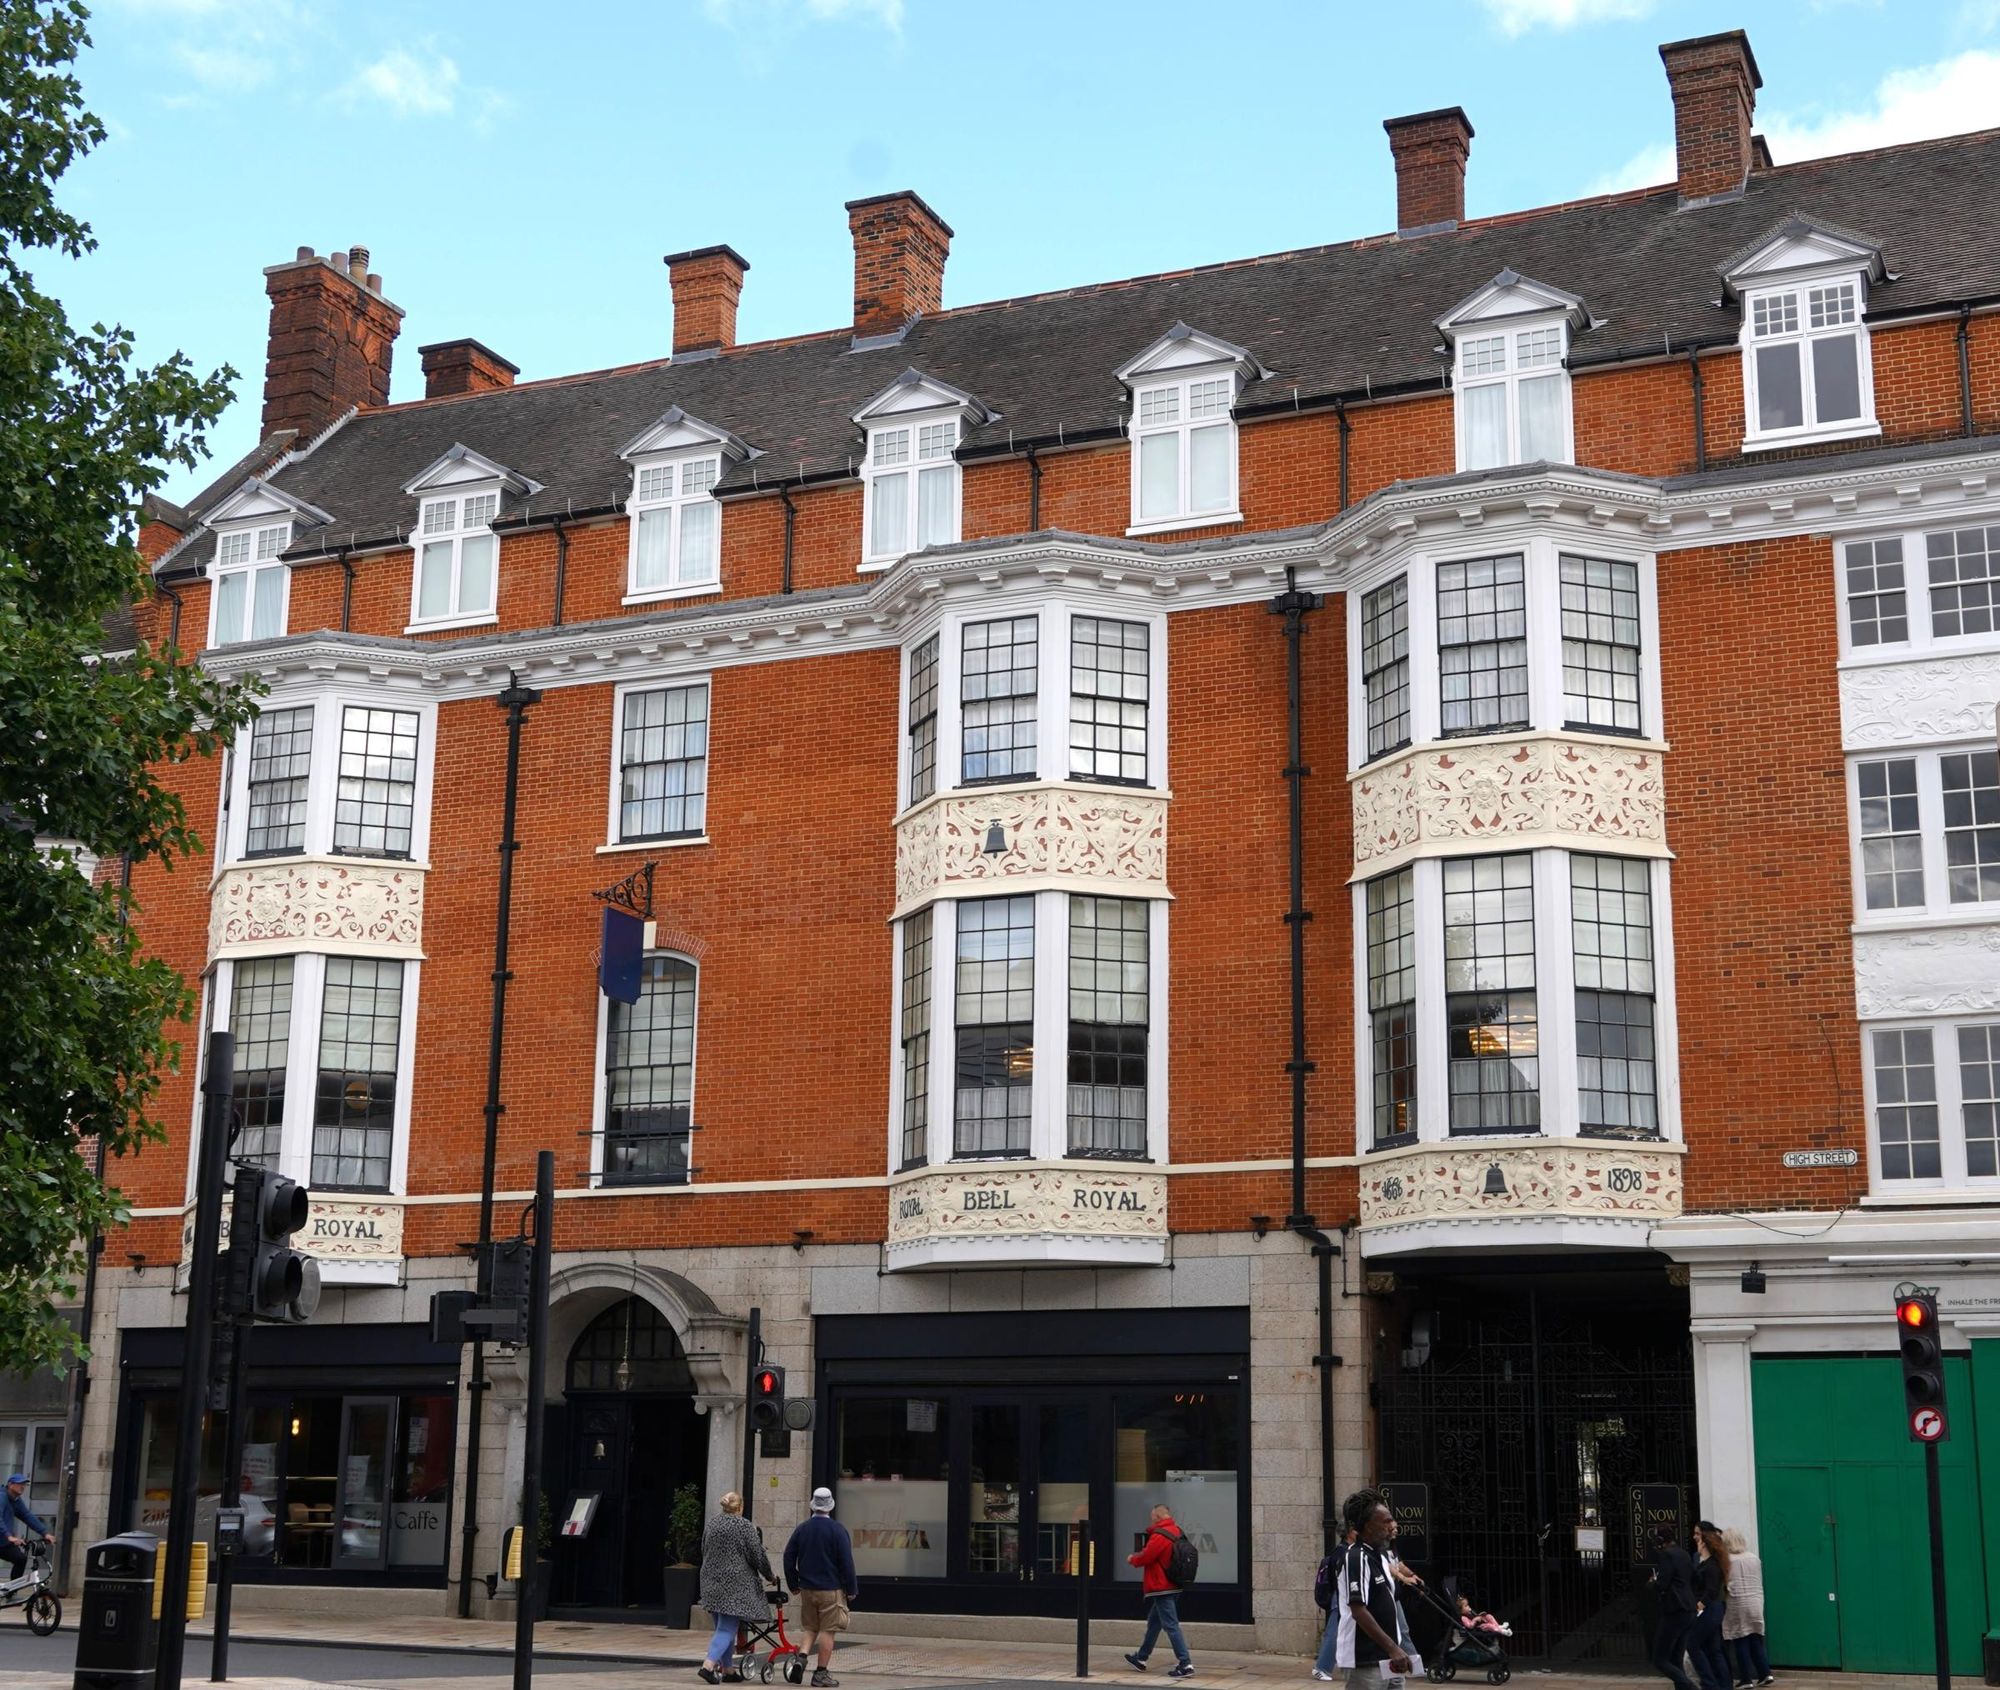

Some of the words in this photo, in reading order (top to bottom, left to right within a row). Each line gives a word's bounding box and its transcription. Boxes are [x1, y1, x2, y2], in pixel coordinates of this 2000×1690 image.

[1789, 1154, 1810, 1164] HIGH
[1814, 1153, 1850, 1163] STREET
[1608, 1168, 1642, 1193] 1898
[899, 1198, 924, 1220] ROYAL
[963, 1190, 1016, 1211] BELL
[1073, 1189, 1147, 1212] ROYAL
[314, 1218, 383, 1239] ROYAL
[395, 1511, 439, 1530] Caffè
[1395, 1506, 1425, 1519] NOW
[1647, 1509, 1677, 1521] NOW
[1632, 1489, 1643, 1560] GARDEN
